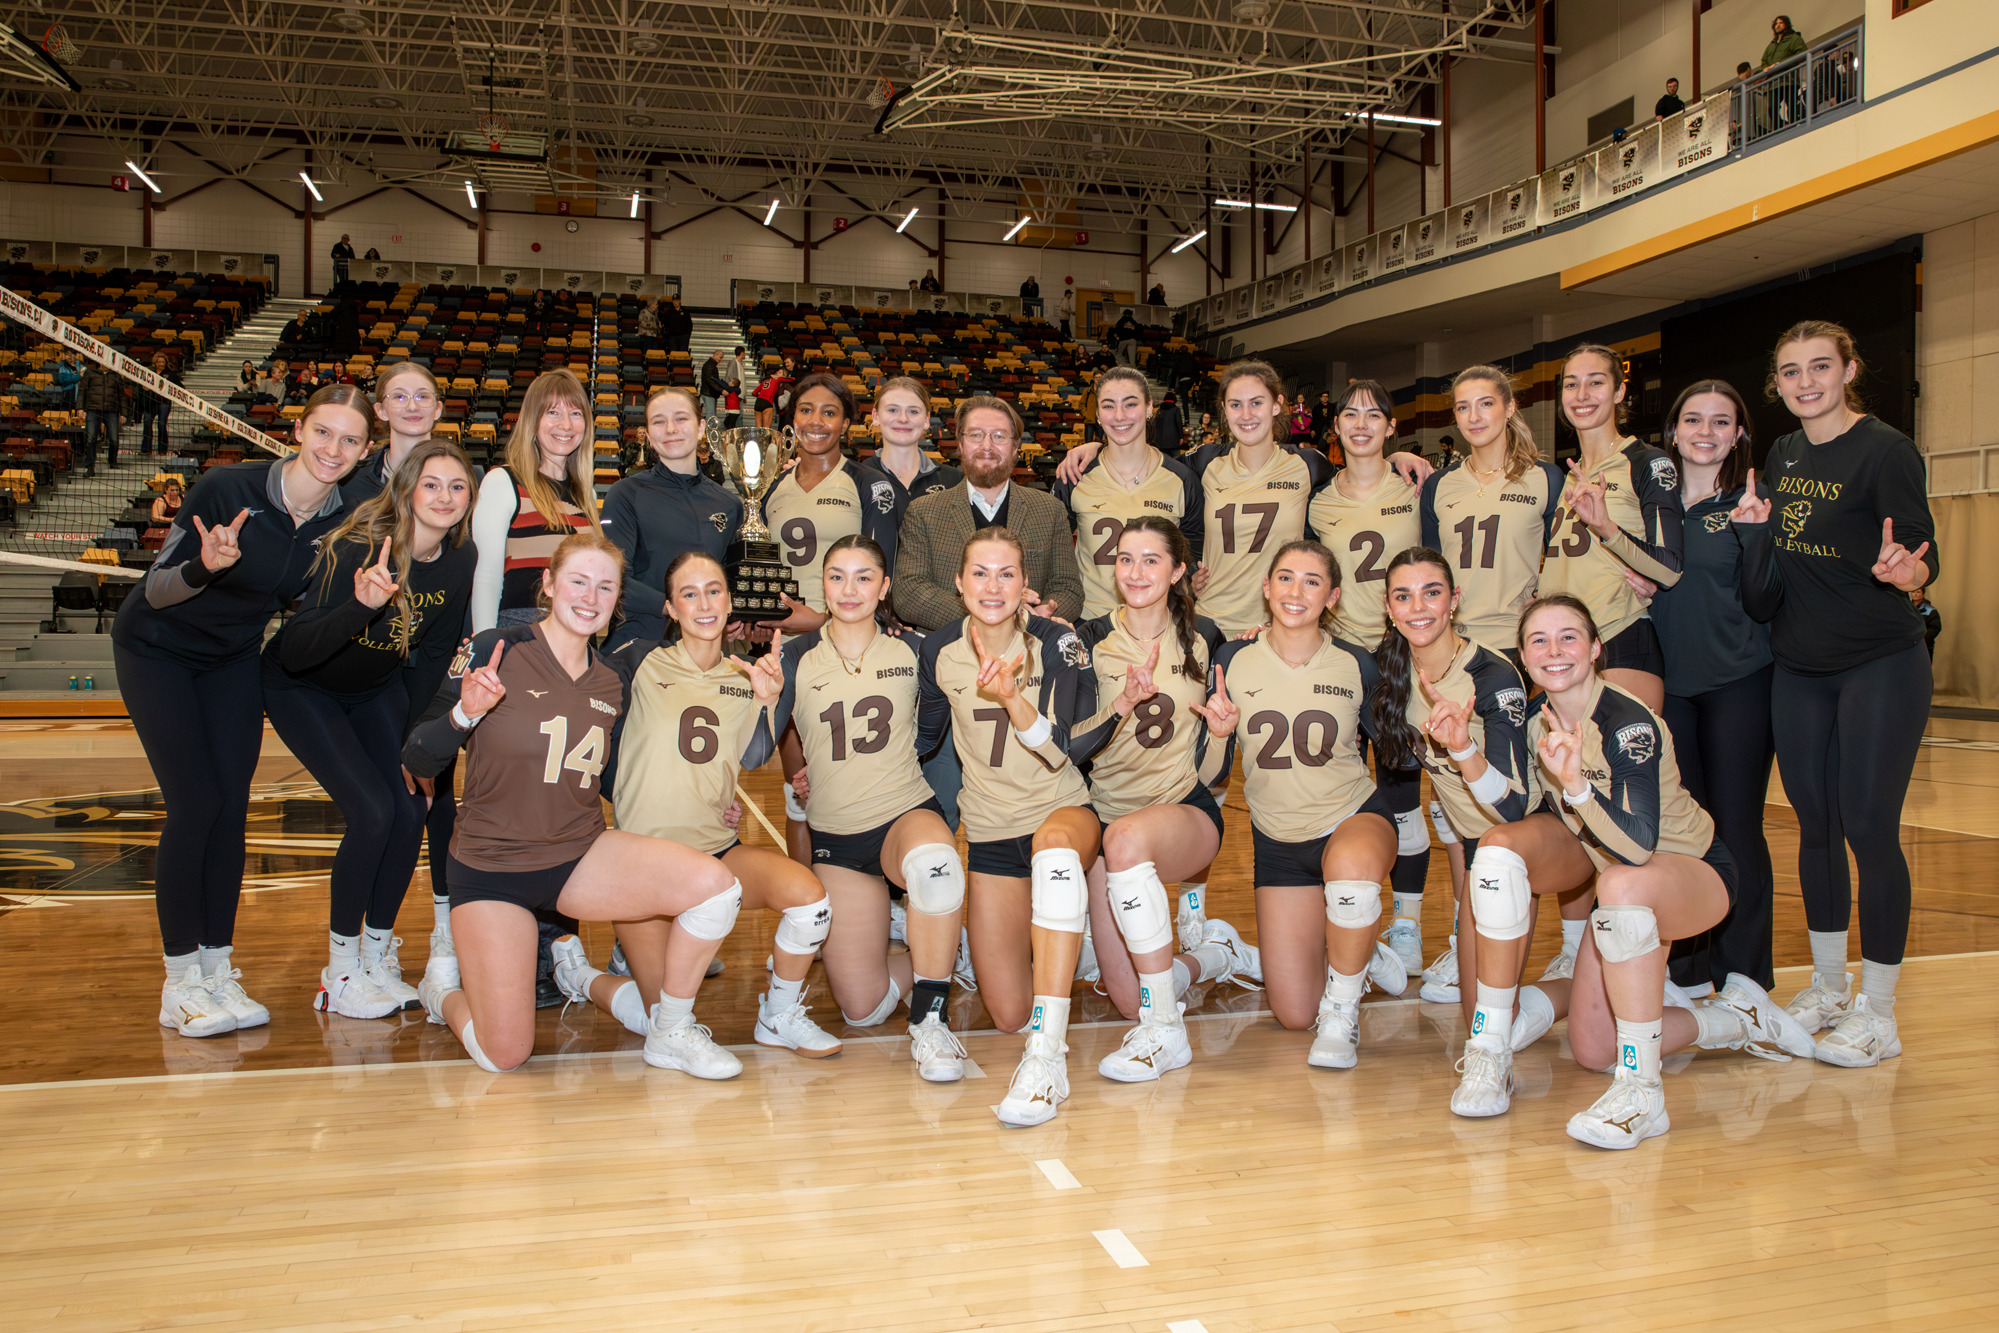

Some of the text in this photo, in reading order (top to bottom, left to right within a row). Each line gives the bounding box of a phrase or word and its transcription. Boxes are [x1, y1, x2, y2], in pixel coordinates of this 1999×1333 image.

[1687, 143, 1699, 153] ARE
[1700, 138, 1712, 147] ALL
[1677, 146, 1713, 168] BISONS
[114, 177, 121, 186] 4
[1621, 172, 1632, 182] ARE
[1632, 168, 1644, 177] ALL
[1612, 175, 1644, 195] BISONS
[560, 202, 567, 211] 3
[1553, 200, 1580, 217] BISONS
[838, 219, 845, 228] 2
[1502, 220, 1526, 234] BISONS
[1081, 233, 1086, 241] 1
[1456, 235, 1478, 248] BISONS
[1415, 248, 1435, 261] BISONS
[1385, 257, 1404, 269] BISONS
[762, 379, 771, 390] 5
[1266, 481, 1300, 491] BISONS
[1776, 476, 1843, 501] BISONS
[816, 497, 852, 508] BISONS
[1144, 500, 1174, 513] BISONS
[1499, 493, 1538, 506] BISONS
[1380, 504, 1413, 516] BISONS
[1214, 502, 1280, 554] 17
[1546, 506, 1592, 558] 23
[780, 516, 818, 567] 9
[1454, 514, 1501, 569] 11
[1349, 530, 1387, 583] 2
[876, 666, 914, 680] BISONS
[719, 685, 754, 700] BISONS
[1313, 684, 1354, 700] BISONS
[819, 694, 894, 762] 13
[1134, 692, 1175, 750] 8
[678, 705, 720, 765] 6
[973, 707, 1010, 768] 7
[1247, 709, 1339, 770] 20
[540, 715, 605, 789] 14
